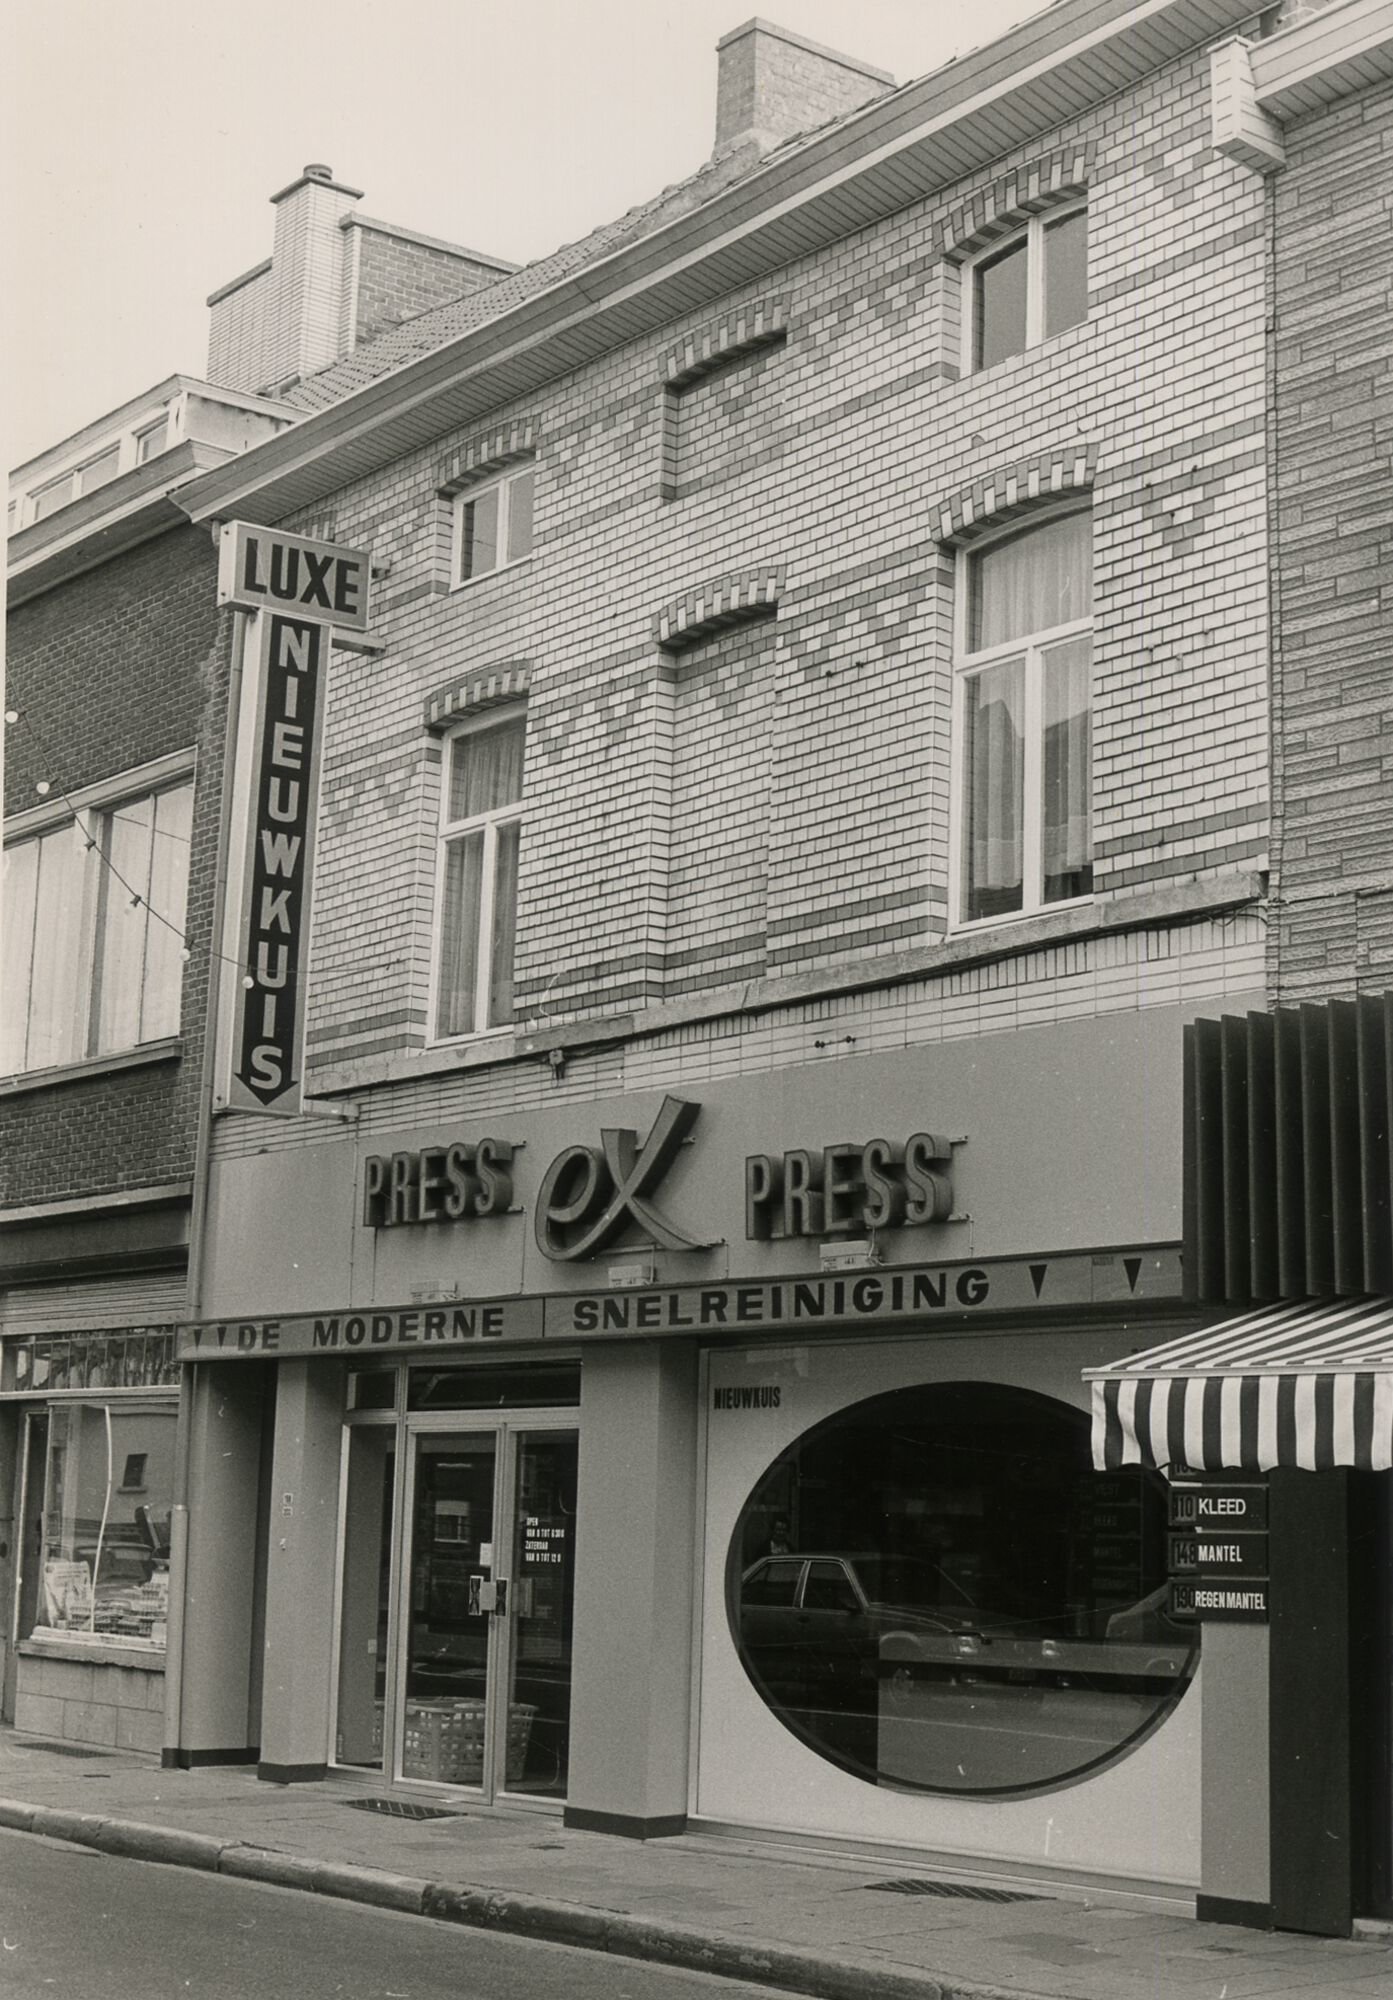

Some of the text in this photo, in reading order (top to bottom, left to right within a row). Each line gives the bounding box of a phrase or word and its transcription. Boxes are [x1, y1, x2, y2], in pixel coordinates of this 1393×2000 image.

[245, 538, 360, 615] LUXE
[250, 624, 311, 1090] NIEUWKUIS
[364, 1137, 513, 1227] PRESS
[745, 1131, 954, 1241] PRESS
[238, 1269, 990, 1351] DE MODERNE SNELREINIGING
[714, 1386, 781, 1409] NIEUWKUIS
[1198, 1498, 1247, 1515] KLEED
[1198, 1545, 1243, 1563] MANTEL
